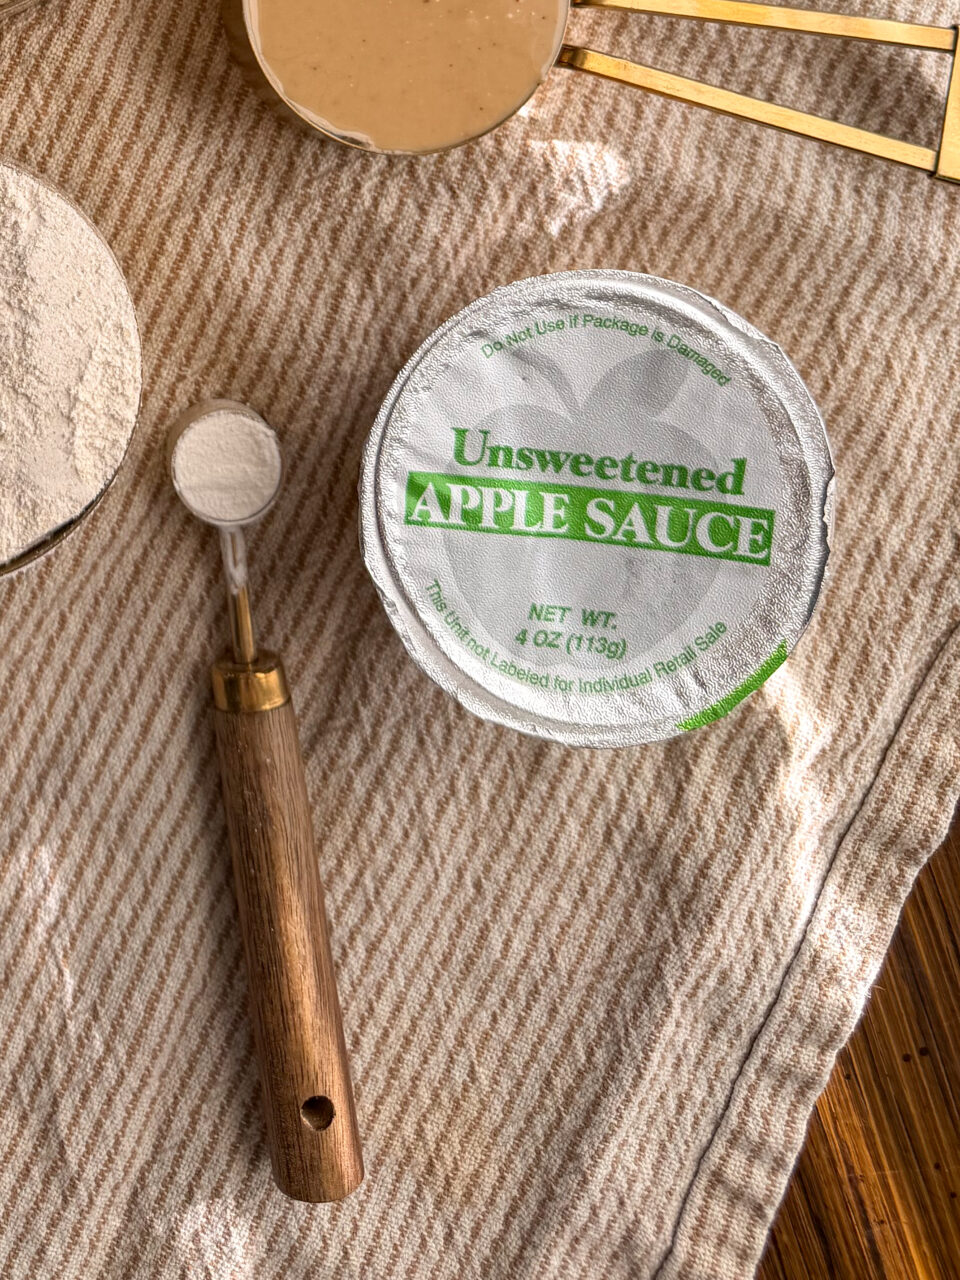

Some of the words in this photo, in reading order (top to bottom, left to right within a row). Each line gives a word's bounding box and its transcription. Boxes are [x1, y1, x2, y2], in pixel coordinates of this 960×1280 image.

[480, 339, 504, 359] Do
[504, 327, 534, 347] Not
[535, 317, 566, 336] Use
[581, 314, 650, 337] Package
[651, 329, 665, 343] is
[666, 333, 732, 387] Damaged
[450, 426, 748, 496] Unsweetened
[409, 481, 570, 534] APPLE
[584, 497, 769, 559] SAUCE
[425, 578, 448, 613] This
[443, 610, 471, 644] Unit
[466, 634, 491, 662] not
[489, 652, 551, 689] Labeled
[553, 675, 575, 693] for
[578, 668, 654, 695] Individual
[652, 644, 697, 679] Retail
[694, 620, 728, 653] Sale
[515, 628, 528, 646] 4
[532, 628, 562, 649] OZ
[566, 631, 628, 661] (113g)
[527, 602, 572, 623] NET
[581, 607, 618, 630] WT.
